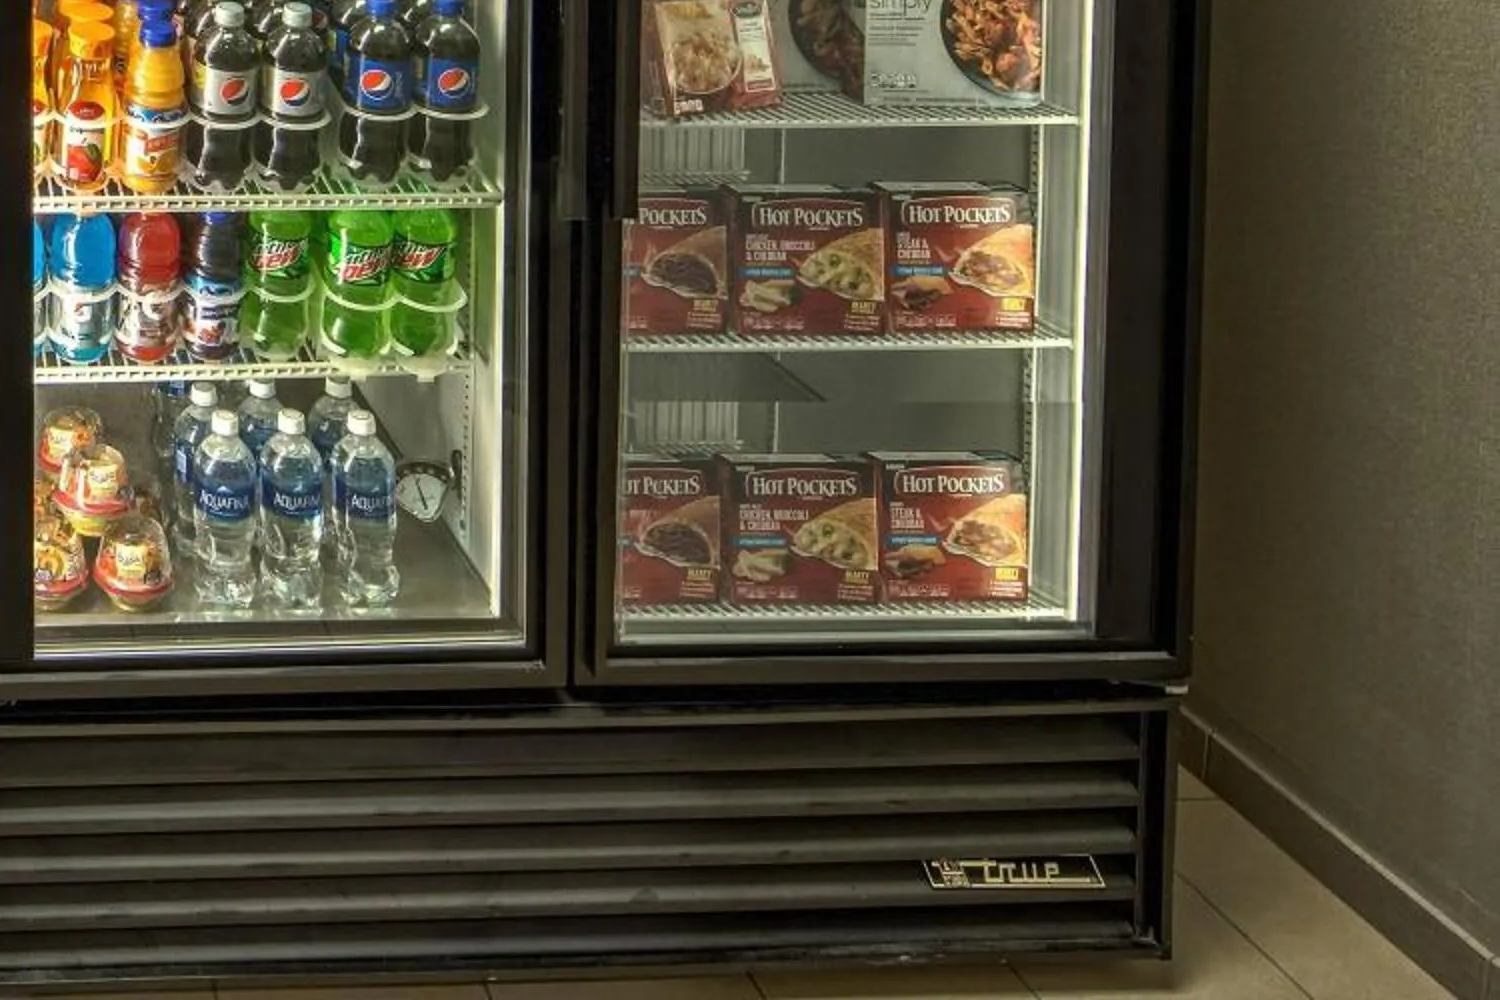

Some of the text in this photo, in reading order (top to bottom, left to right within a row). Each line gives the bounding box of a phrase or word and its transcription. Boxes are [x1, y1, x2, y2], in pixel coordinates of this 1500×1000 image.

[639, 206, 707, 225] POCKETS
[759, 207, 864, 227] HOT POCKETS
[909, 204, 1011, 224] HOT POCKETS
[643, 475, 700, 495] PKETS
[752, 477, 857, 496] HOT POCKETS
[902, 473, 1004, 493] HOT POCKETS
